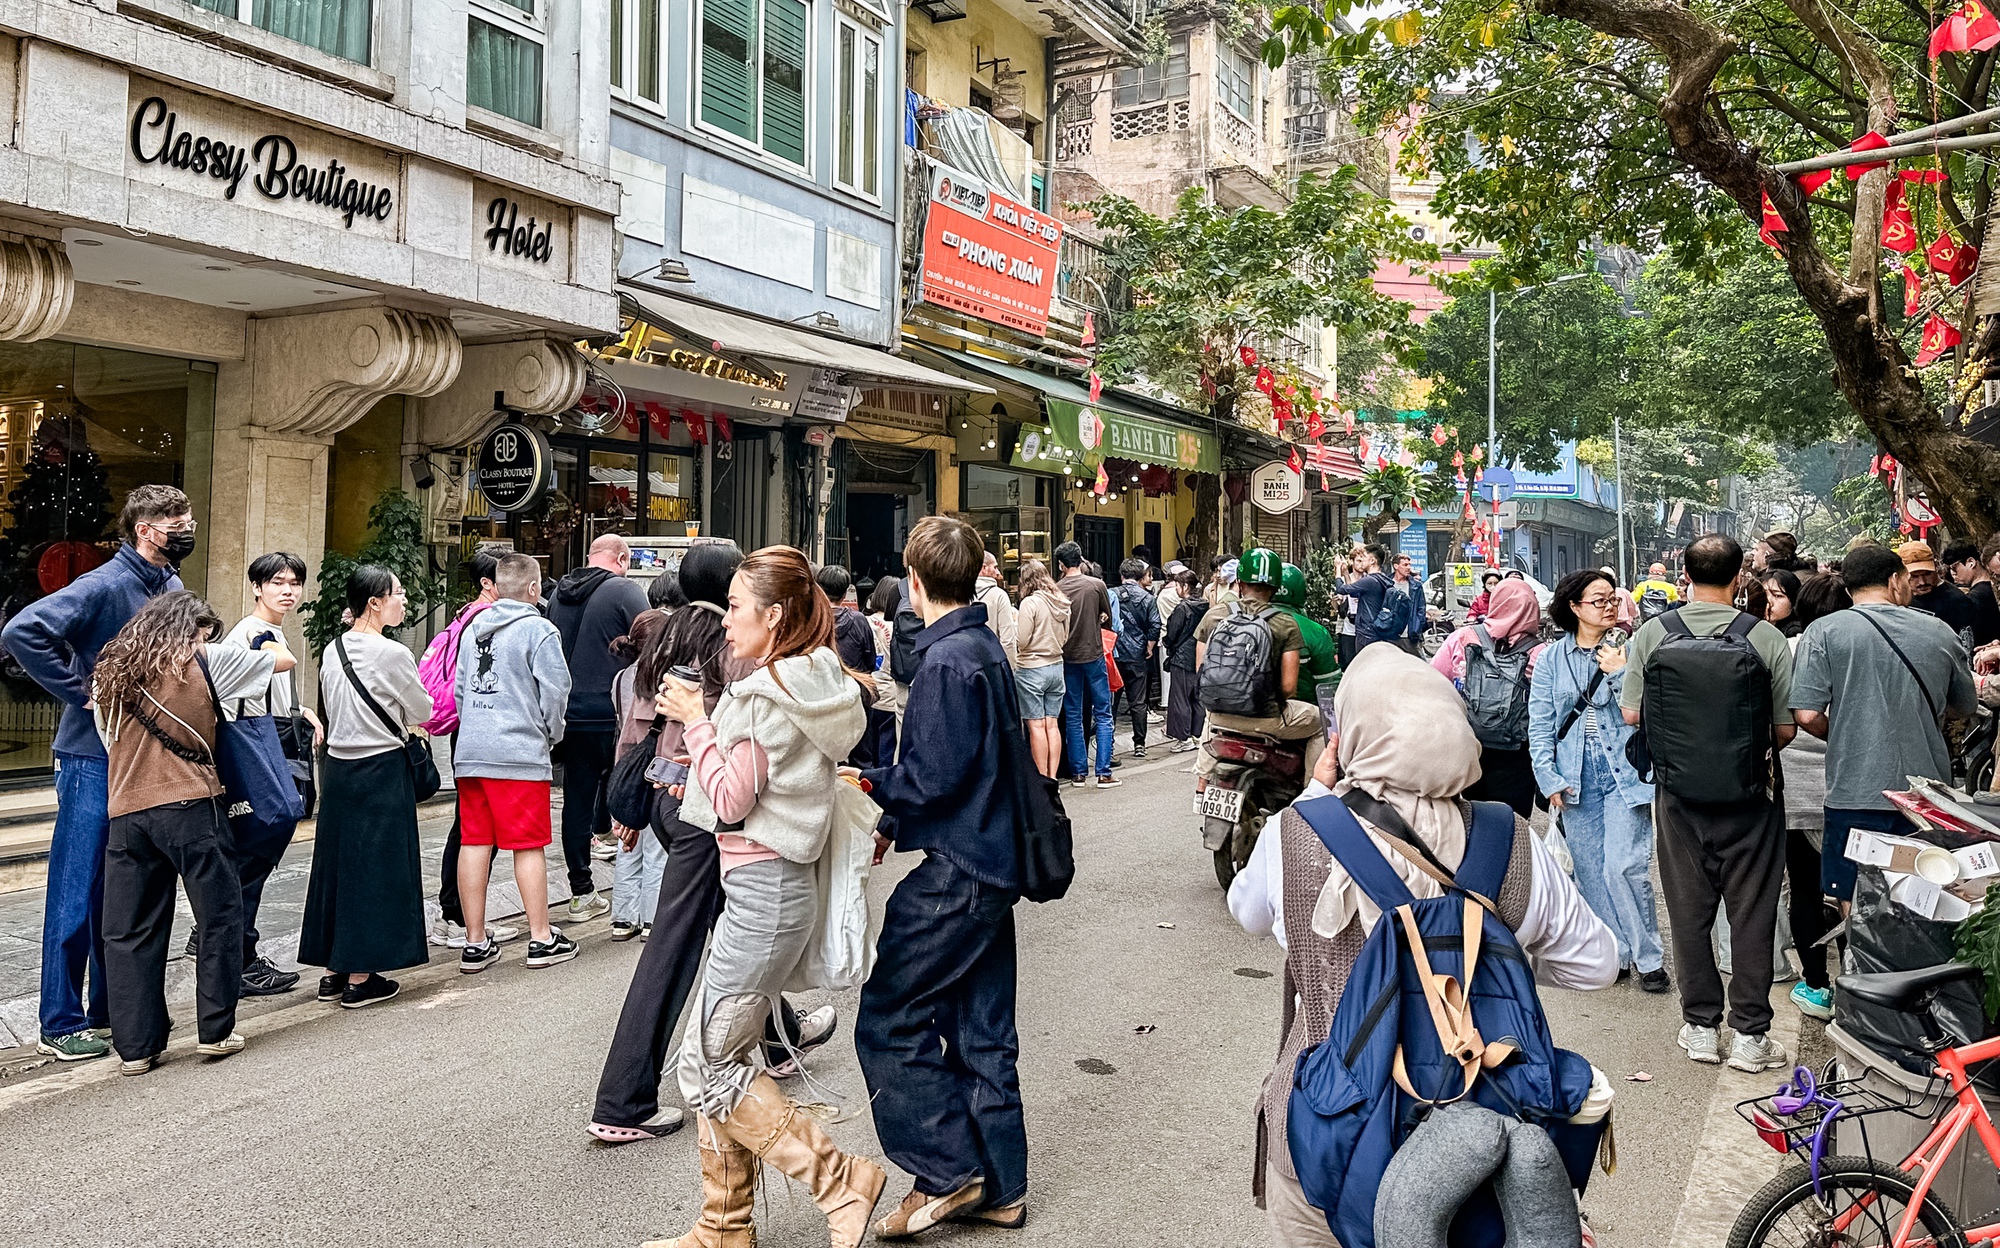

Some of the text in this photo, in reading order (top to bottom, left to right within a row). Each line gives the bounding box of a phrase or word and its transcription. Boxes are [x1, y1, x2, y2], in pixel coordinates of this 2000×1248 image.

[130, 96, 393, 229] Classy Boutique
[993, 203, 1019, 227] KHÓA
[484, 197, 553, 263] Hotel
[959, 238, 1044, 286] PHONG XUÂN
[716, 440, 732, 460] 23
[1111, 424, 1199, 466] BANH MI 25
[1263, 482, 1289, 490] BANH
[650, 495, 672, 521] FACIAL
[1207, 788, 1238, 806] 29-K2
[1202, 801, 1237, 821] 099.04
